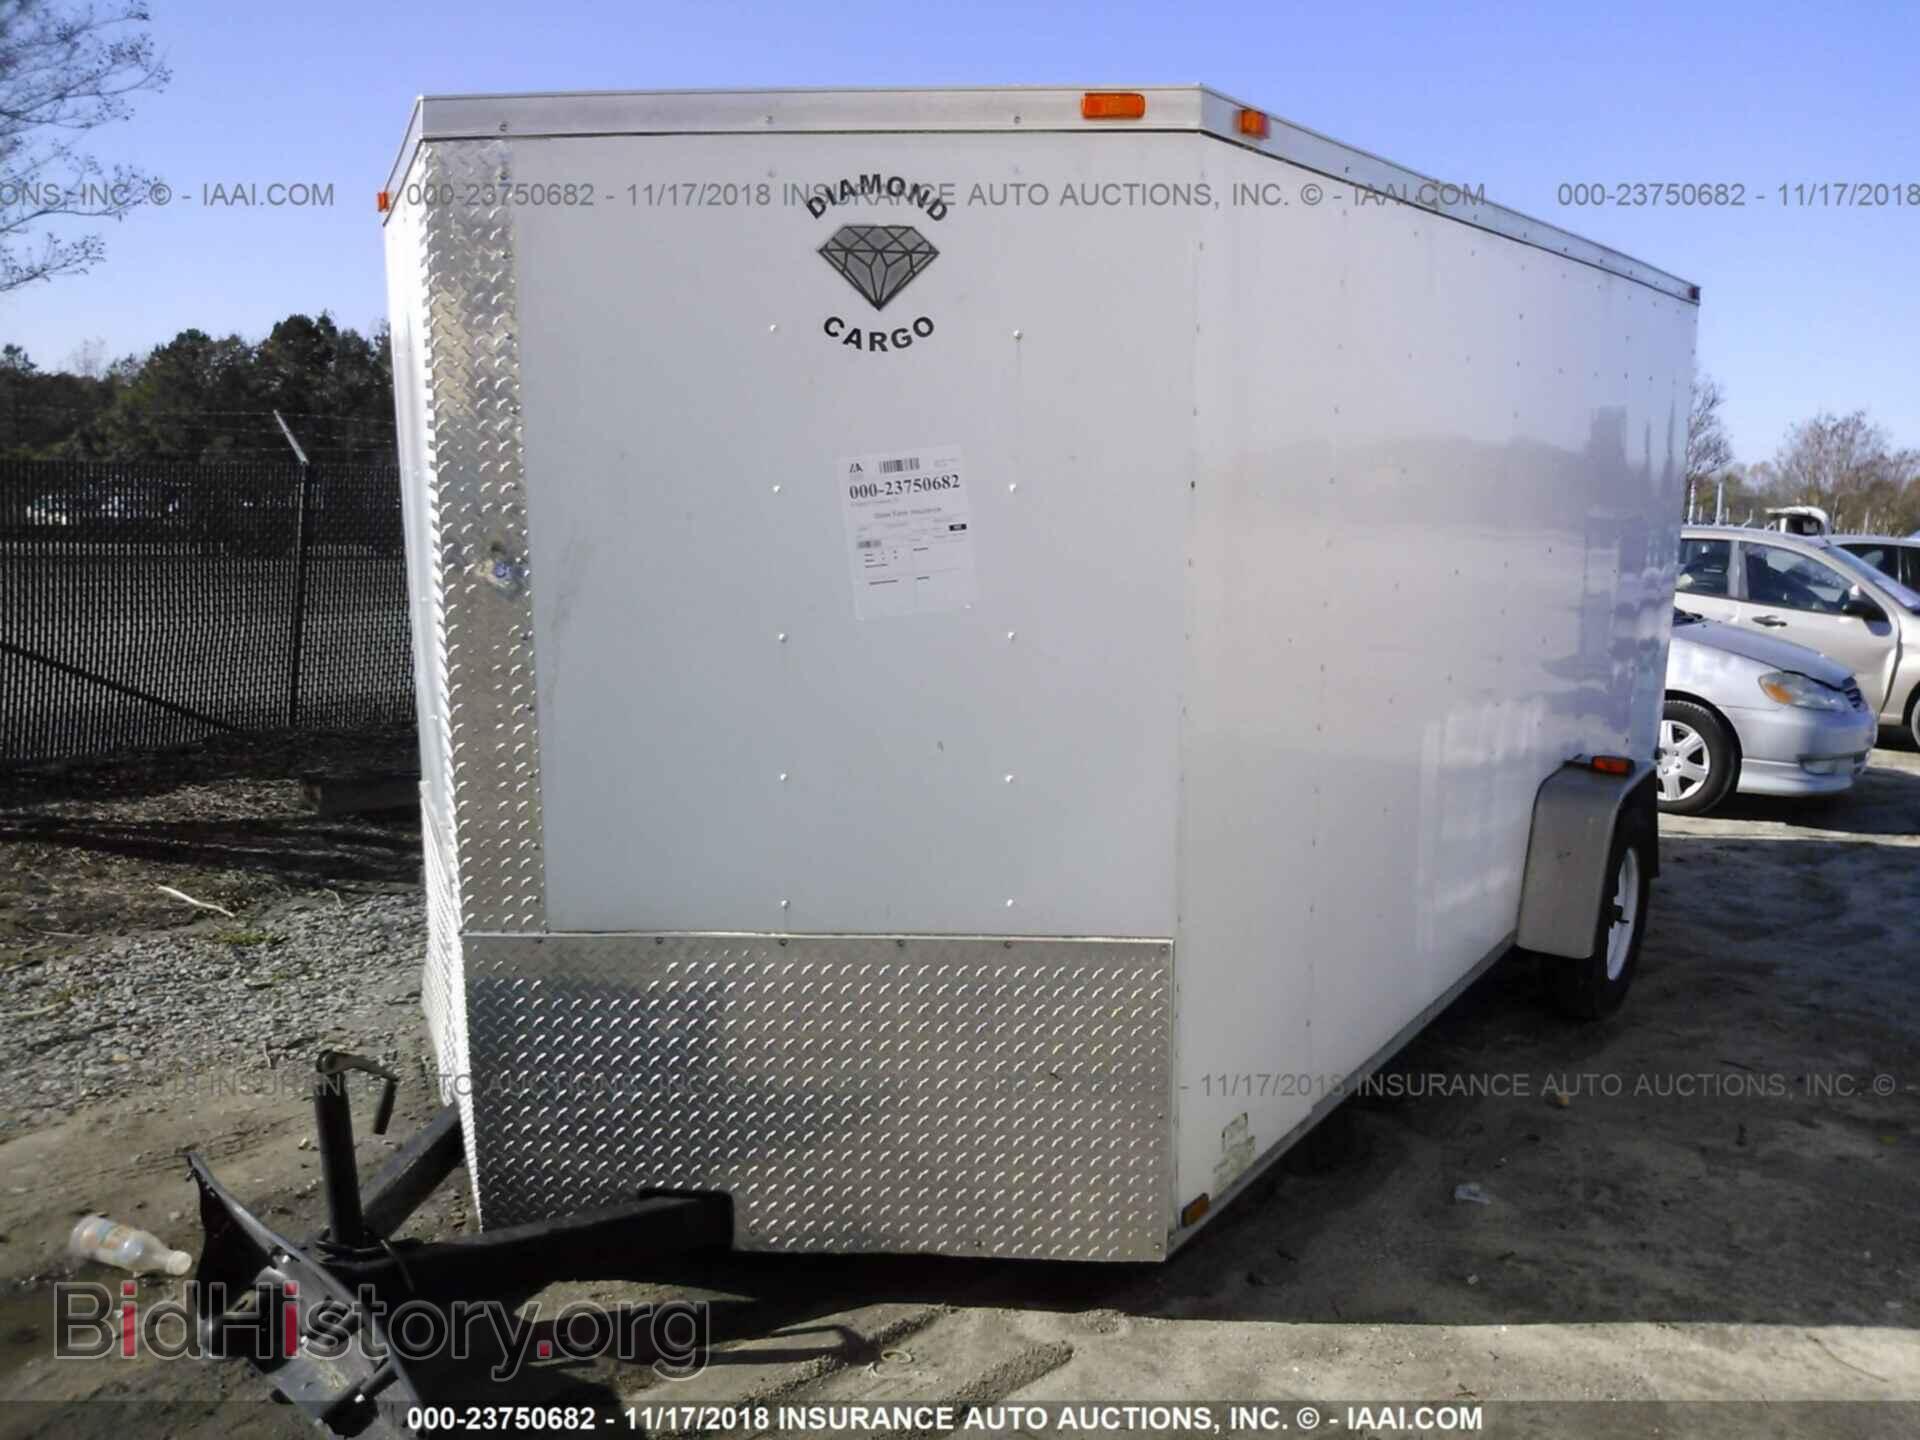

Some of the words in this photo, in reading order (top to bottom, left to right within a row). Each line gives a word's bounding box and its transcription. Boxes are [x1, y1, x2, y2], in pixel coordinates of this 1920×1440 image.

[806, 173, 948, 221] DIAMOND
[823, 316, 934, 352] CARGO
[849, 474, 960, 499] 000-23750682
